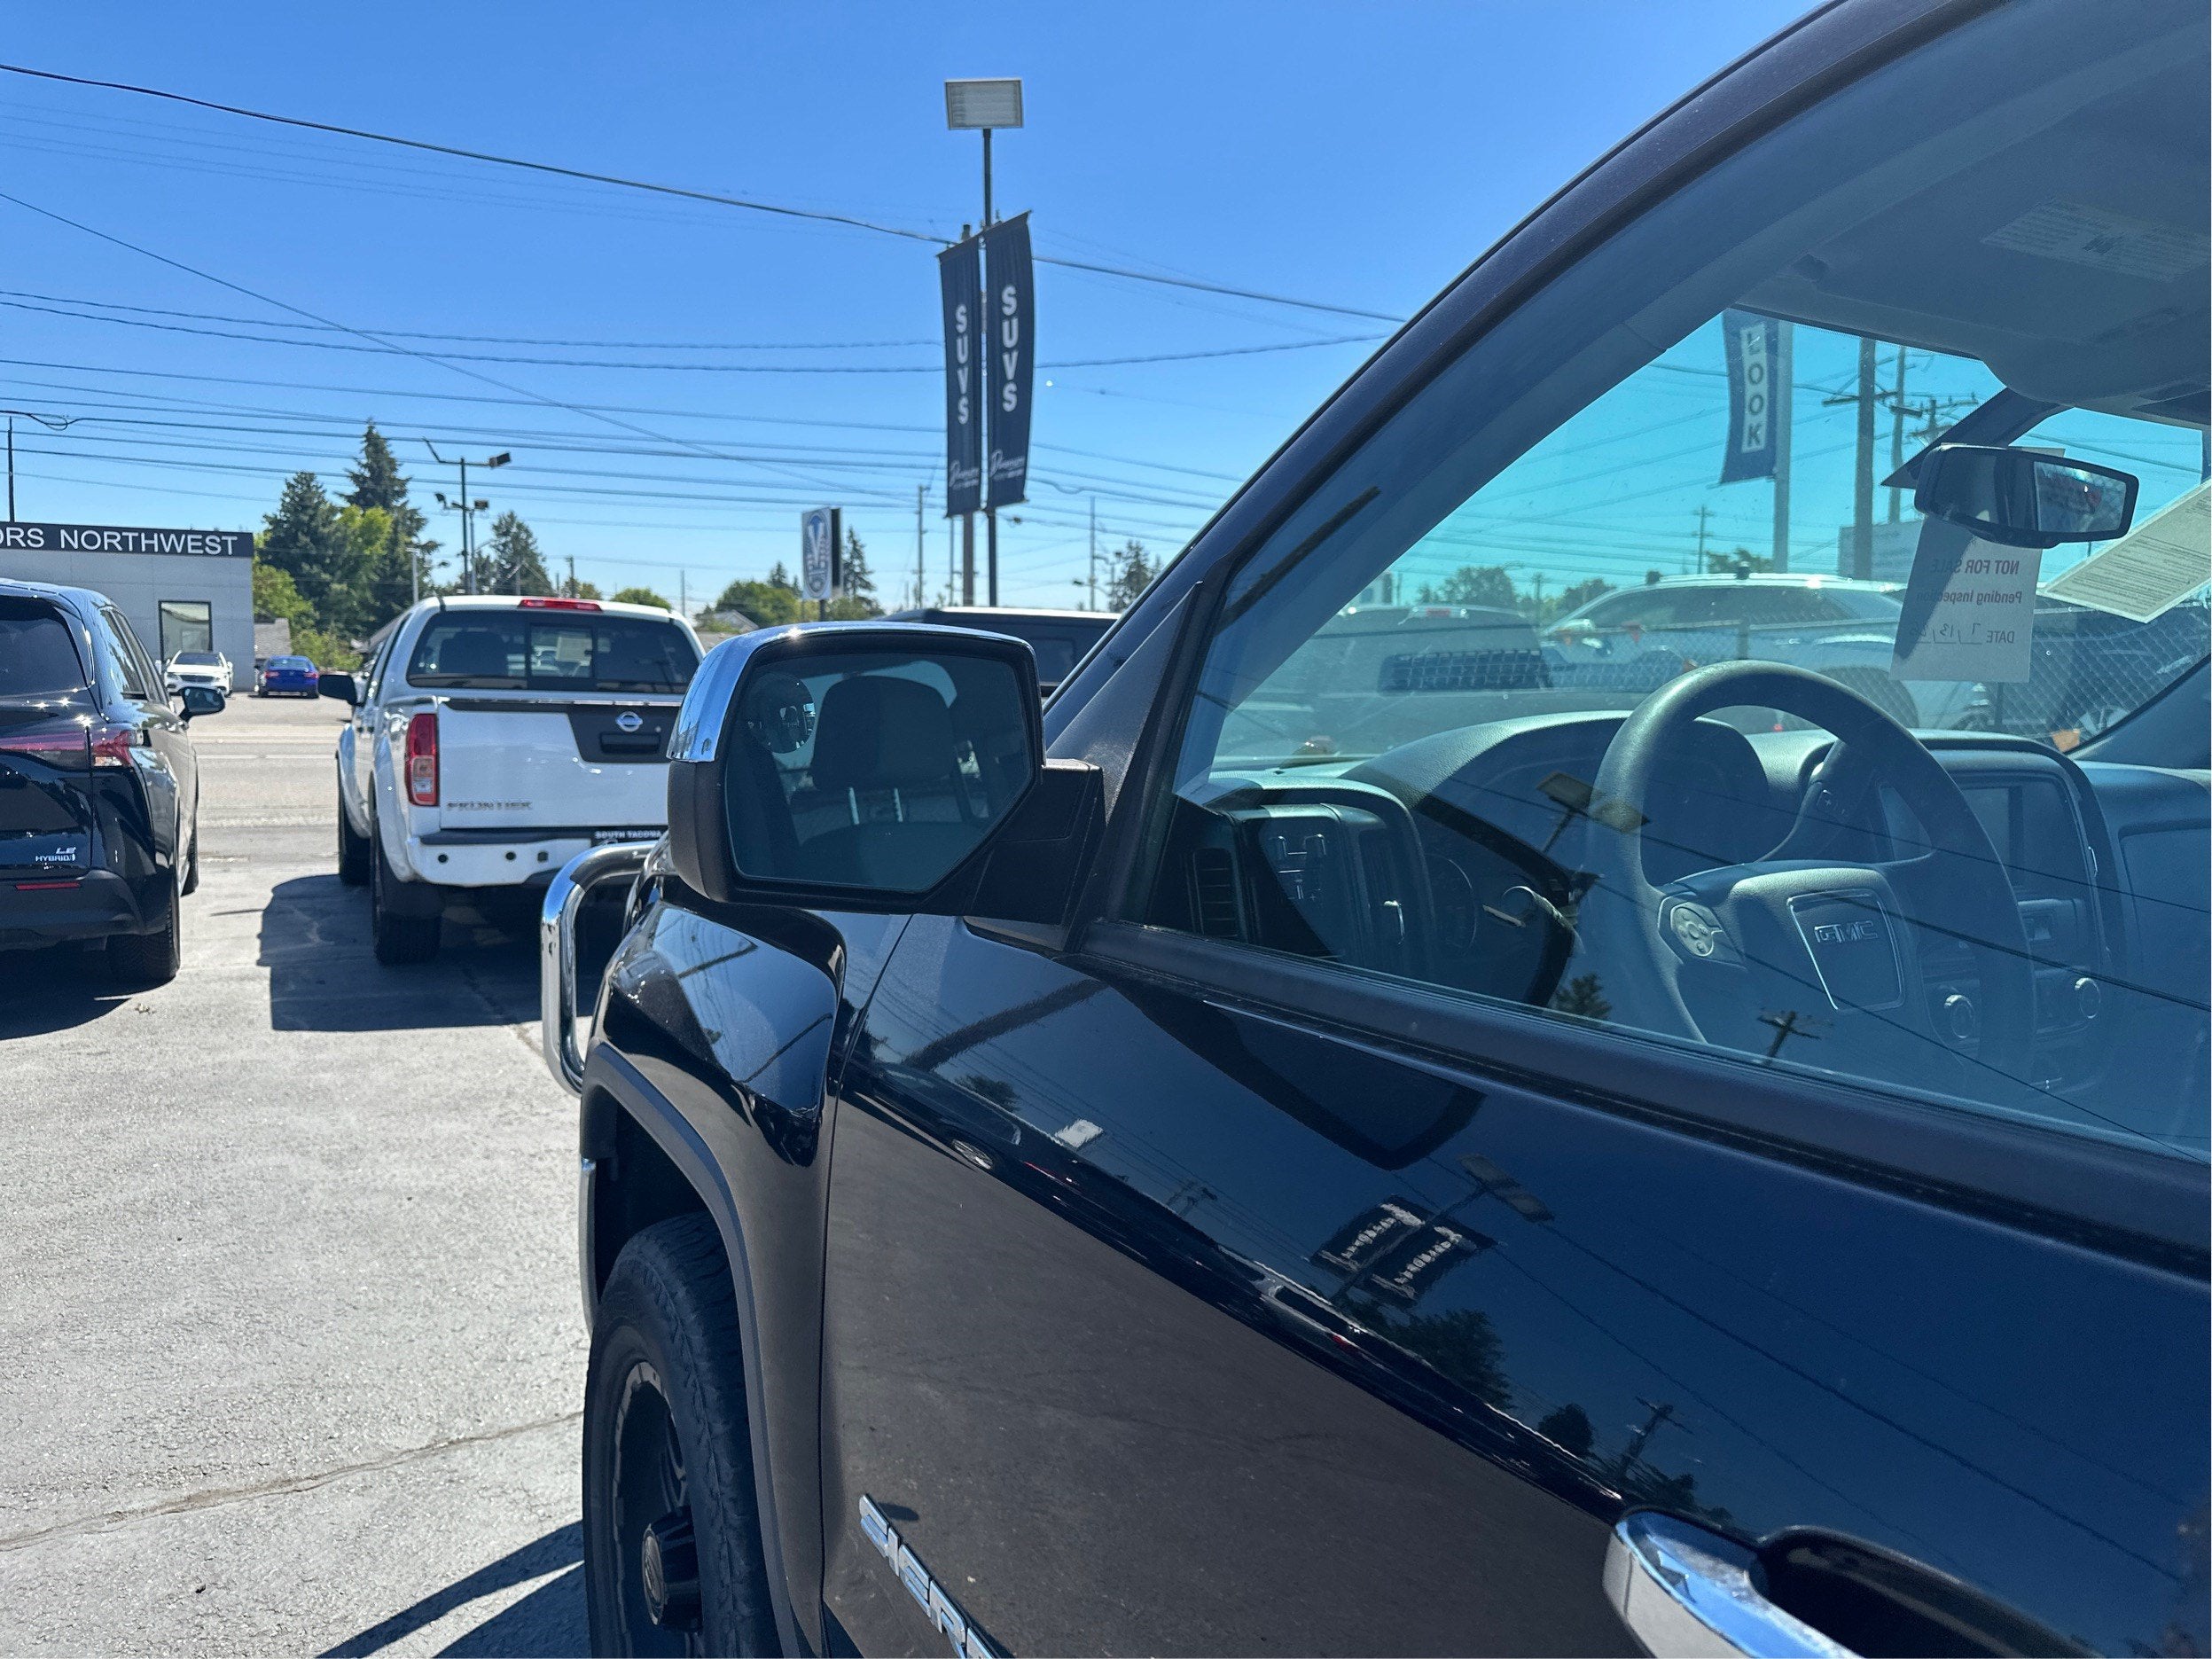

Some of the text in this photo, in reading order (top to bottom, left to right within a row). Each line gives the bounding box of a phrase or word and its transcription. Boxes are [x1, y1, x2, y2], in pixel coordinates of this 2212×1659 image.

[955, 304, 969, 425] SUVS
[1002, 285, 1019, 412] SUVS
[1747, 332, 1764, 448] LOOK
[60, 528, 238, 555] NORTHWEST
[1814, 920, 1878, 943] GMC
